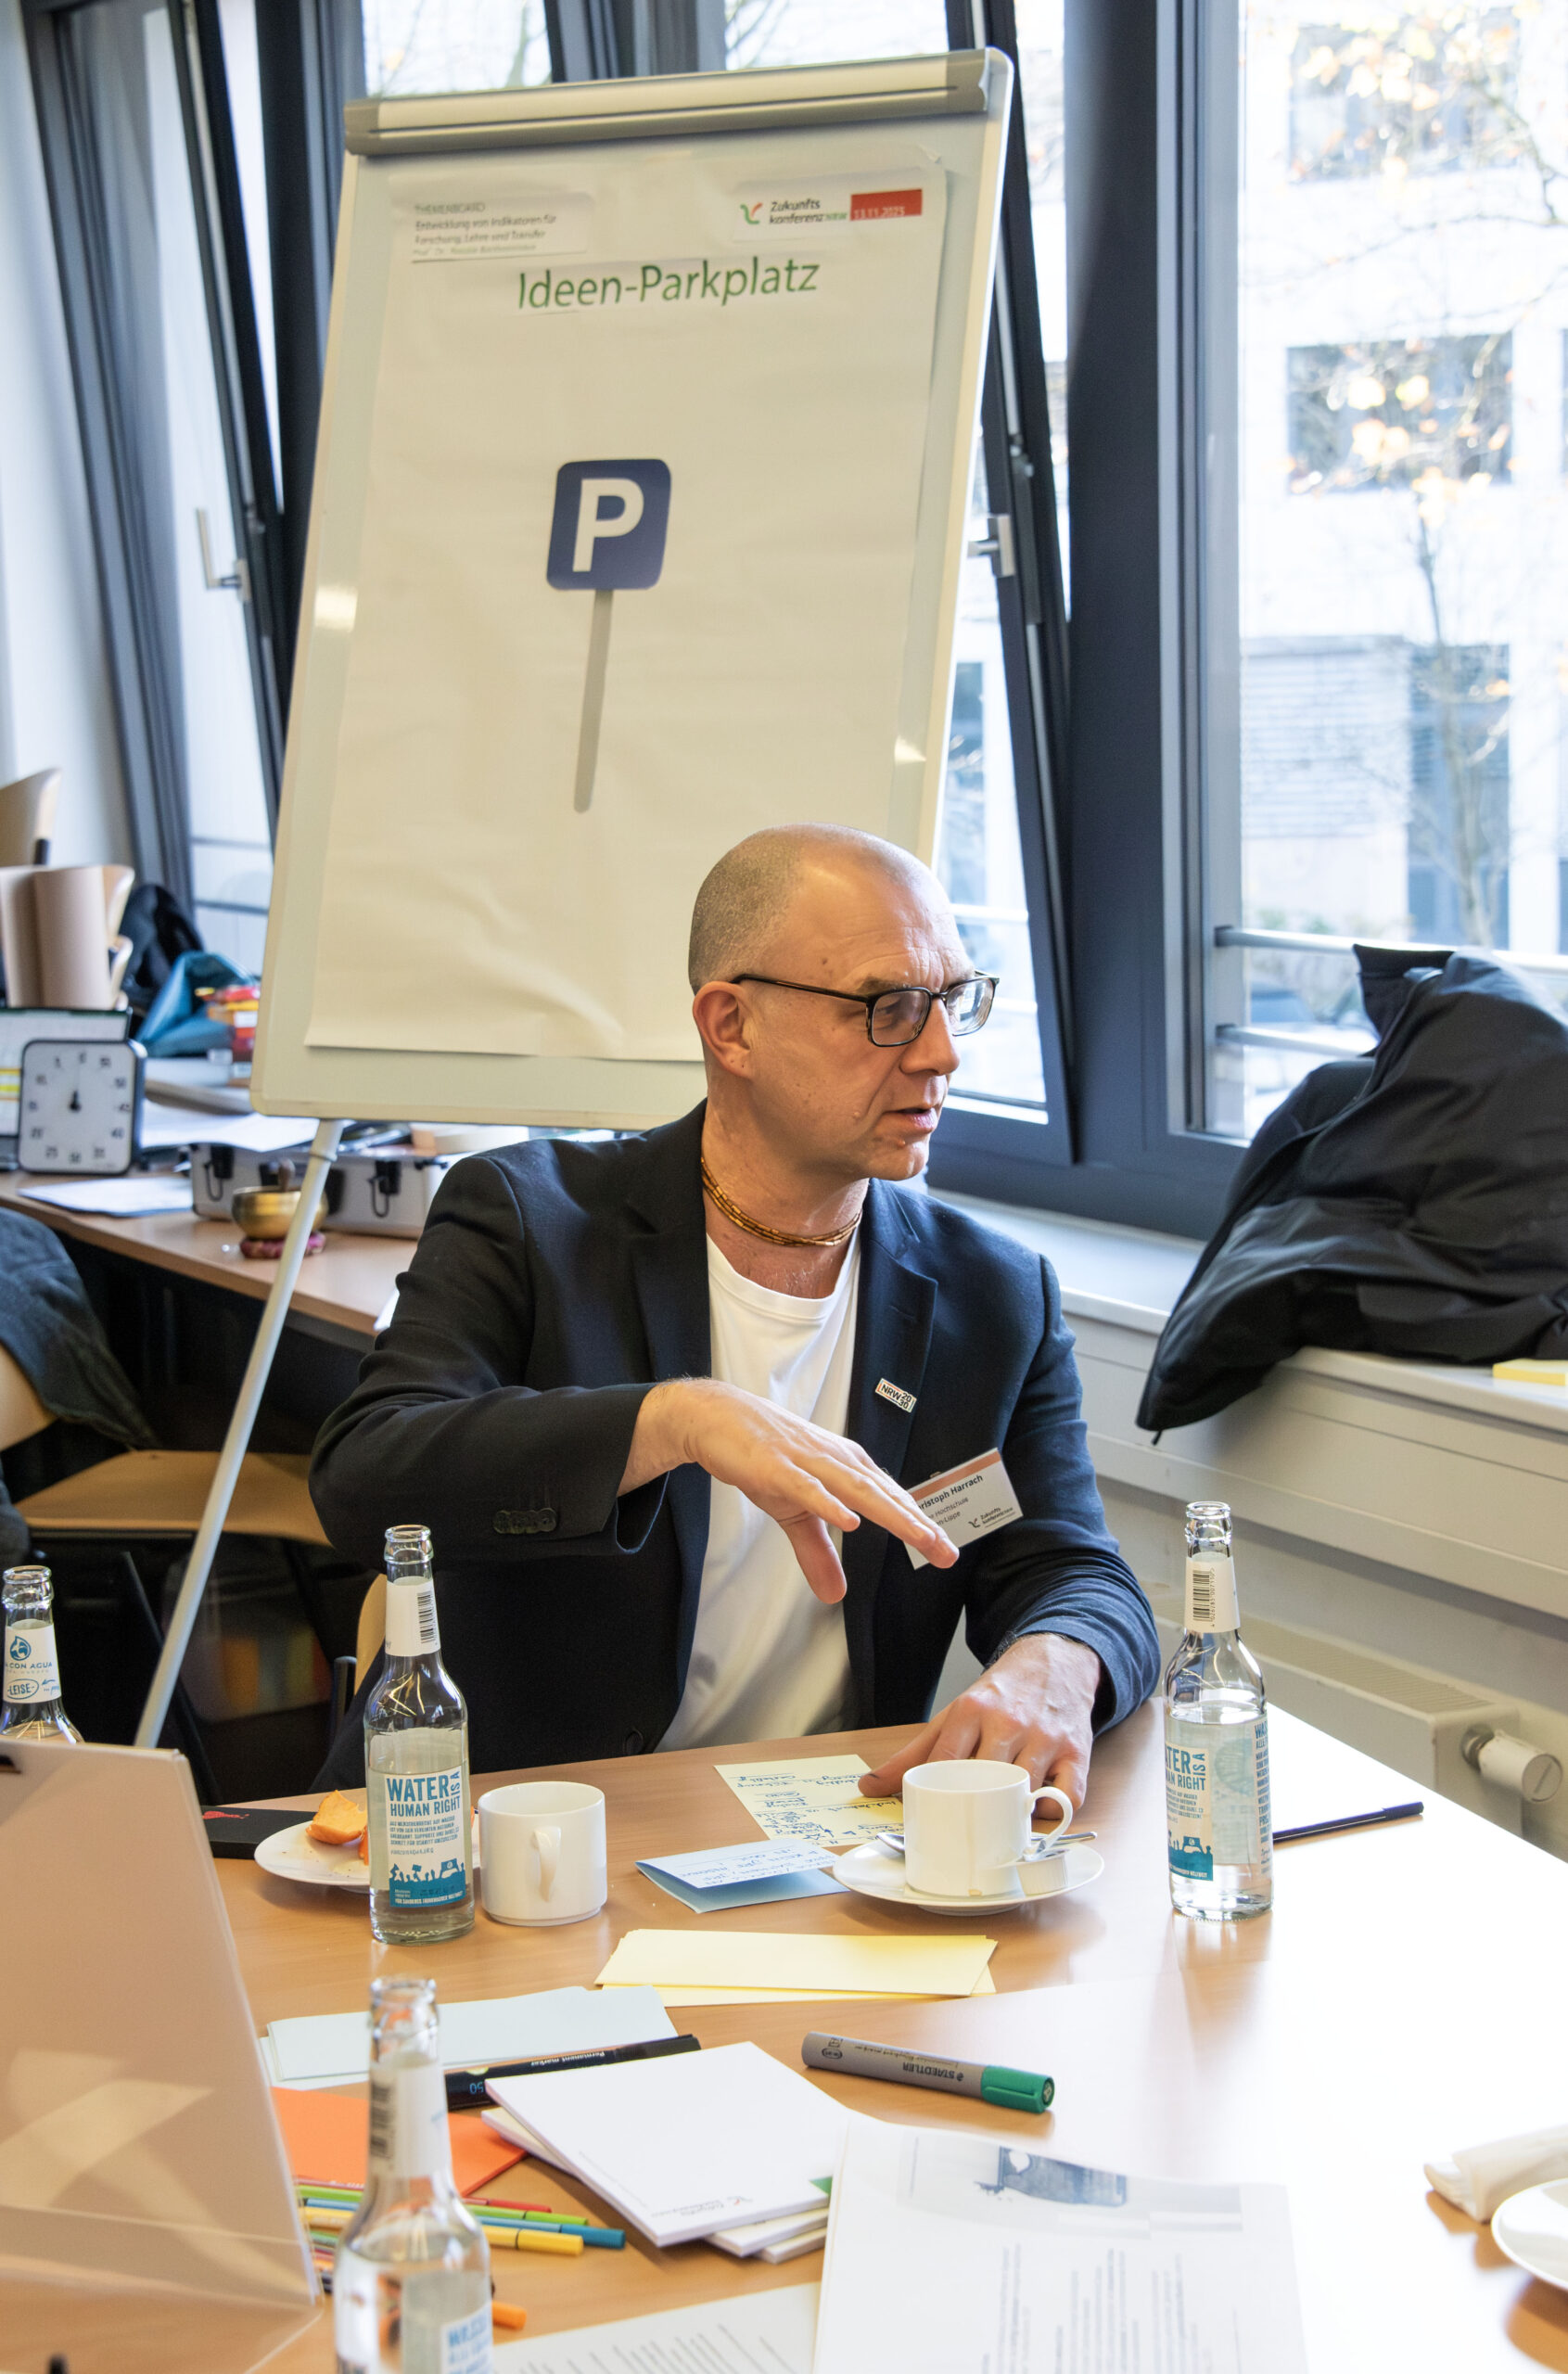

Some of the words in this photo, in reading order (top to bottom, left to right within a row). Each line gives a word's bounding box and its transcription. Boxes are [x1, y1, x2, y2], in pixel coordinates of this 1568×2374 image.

[771, 198, 821, 211] Zukunfts
[415, 220, 470, 231] Entwicklung
[473, 219, 489, 227] von
[491, 215, 542, 226] Indikatoren
[518, 256, 821, 309] Ideen-Parkplatz
[572, 478, 644, 572] P
[881, 1384, 902, 1401] NRW
[901, 1392, 912, 1403] 20
[898, 1399, 909, 1410] 30
[918, 1490, 950, 1511] hristoph
[950, 1474, 983, 1496] Harrach
[935, 1497, 969, 1517] Hochschule
[1192, 1753, 1205, 1761] A
[450, 1770, 461, 1780] A
[1192, 1764, 1206, 1776] IS
[386, 1774, 449, 1802] WATER
[450, 1781, 461, 1796] IS
[1177, 1773, 1206, 1791] RIGHT
[389, 1803, 430, 1818] HUMAN
[433, 1795, 461, 1815] RIGHT
[530, 2058, 560, 2067] marker
[561, 2051, 606, 2063] Permanent
[902, 2061, 955, 2080] STAEDTLER
